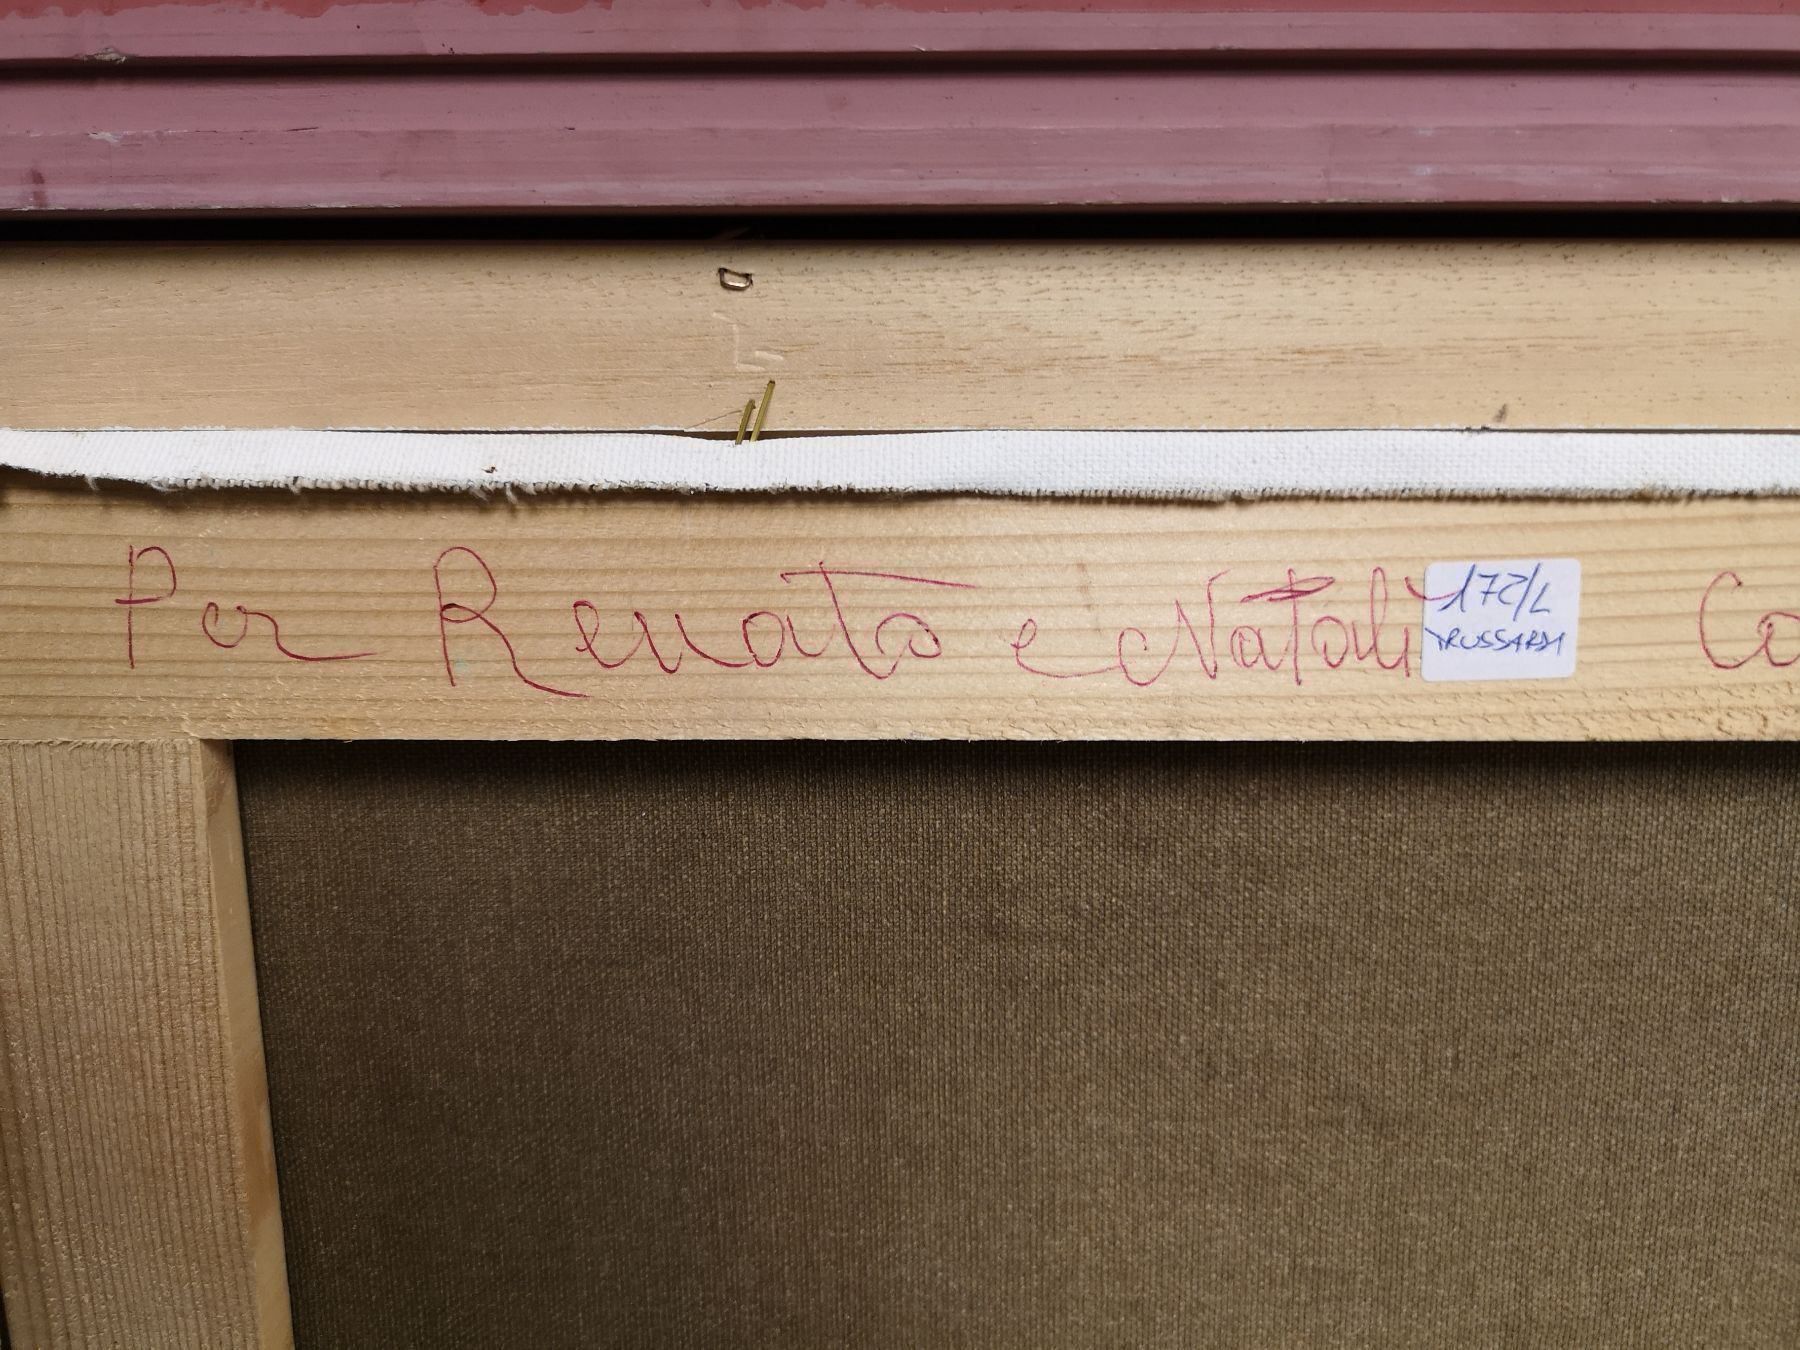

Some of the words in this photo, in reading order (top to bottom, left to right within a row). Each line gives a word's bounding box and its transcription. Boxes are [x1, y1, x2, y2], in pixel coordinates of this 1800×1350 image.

[115, 544, 378, 669] Per
[433, 546, 978, 698] Renato
[1012, 618, 1118, 678] e
